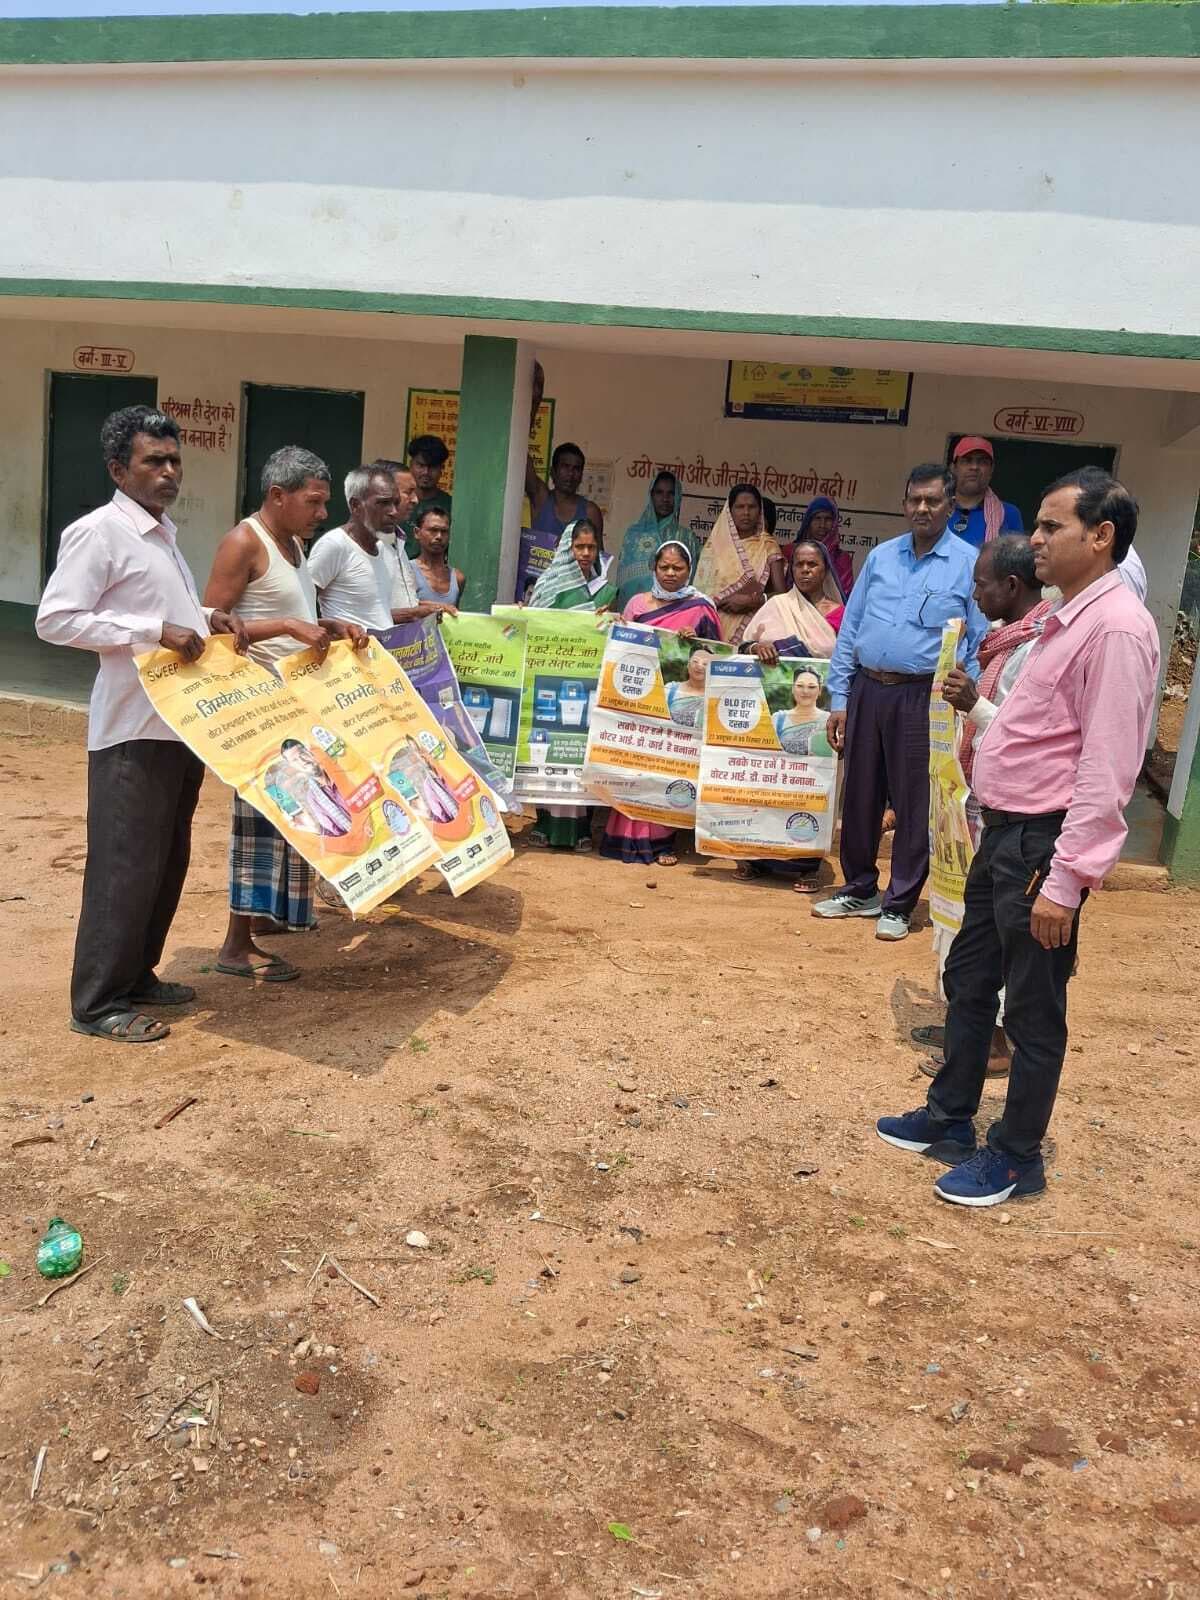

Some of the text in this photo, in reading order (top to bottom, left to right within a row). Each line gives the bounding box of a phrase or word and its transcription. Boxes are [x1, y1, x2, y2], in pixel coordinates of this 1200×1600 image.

[221, 402, 235, 423] को
[626, 454, 652, 479] उठो
[686, 454, 712, 487] और
[763, 465, 788, 498] लिए
[620, 663, 635, 674] BLO
[724, 698, 739, 707] BLO
[728, 756, 749, 767] सबके
[710, 768, 728, 780] वोटर
